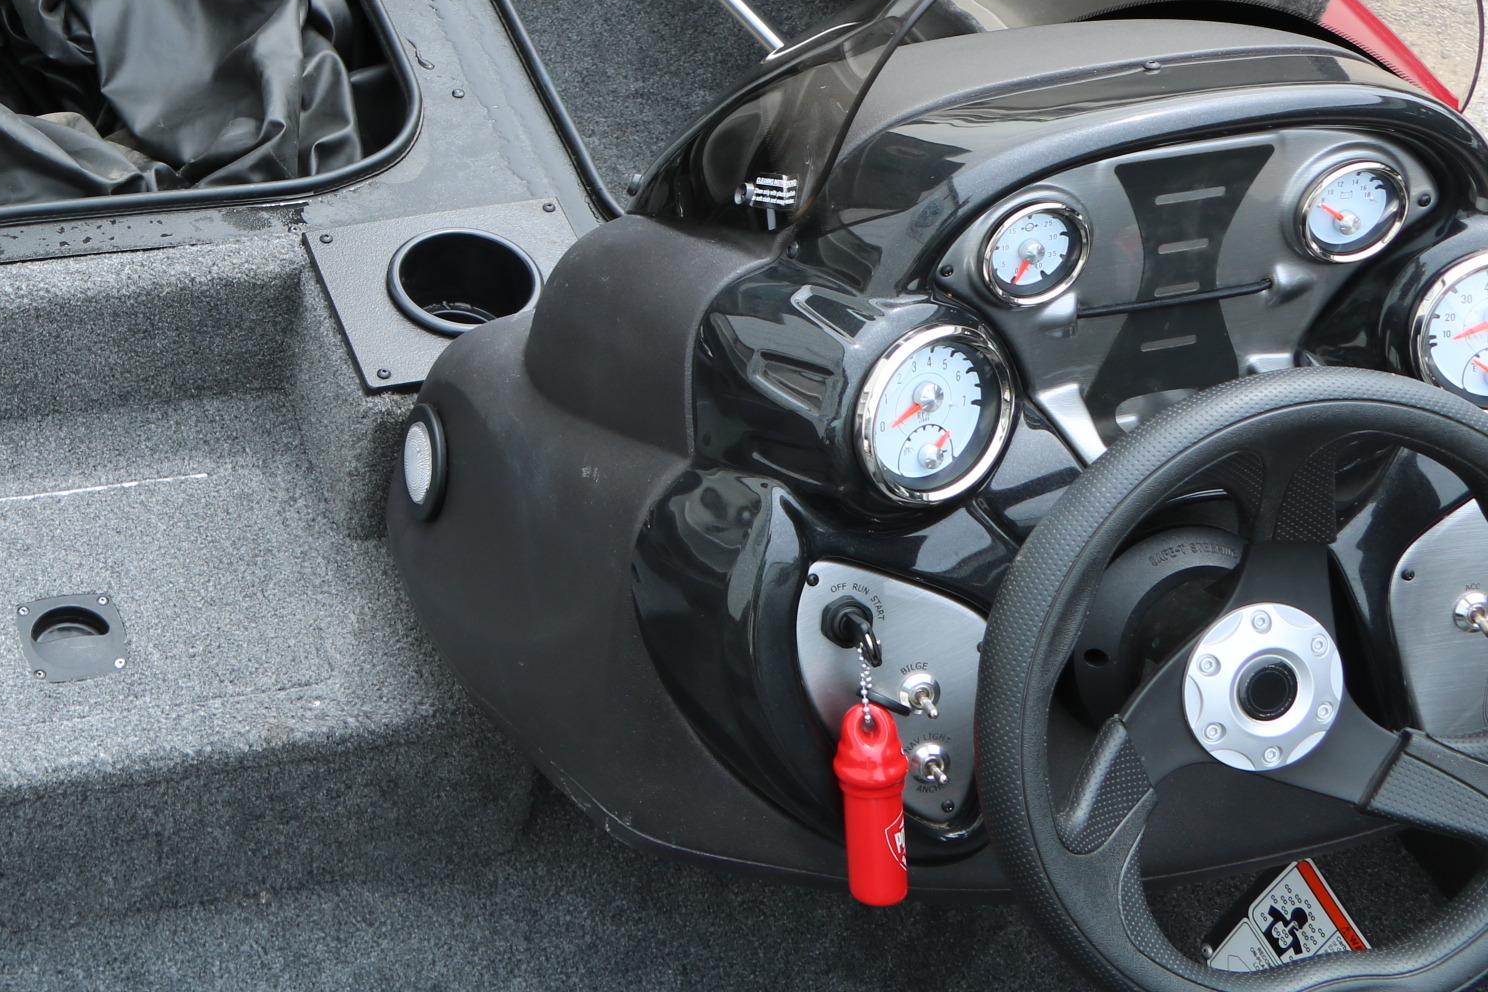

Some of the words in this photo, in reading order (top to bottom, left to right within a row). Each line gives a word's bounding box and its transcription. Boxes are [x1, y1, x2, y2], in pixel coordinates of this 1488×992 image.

[1460, 294, 1473, 304] 30
[1445, 312, 1456, 322] 20
[1443, 329, 1451, 338] 10
[927, 356, 932, 367] 4
[943, 358, 948, 370] 5
[912, 361, 917, 373] 3
[955, 371, 961, 382] 6
[879, 420, 886, 433] 0
[830, 582, 848, 593] OFF
[852, 583, 870, 595] RUN
[870, 595, 885, 621] START
[900, 661, 929, 676] BILGE
[904, 736, 920, 754] NAV
[923, 732, 951, 744] LIGHT
[1285, 884, 1292, 894] CO
[1271, 895, 1278, 904] CO
[1281, 895, 1288, 905] CO
[1288, 896, 1295, 906] CO
[1295, 894, 1302, 903] CO
[1304, 899, 1311, 909] CO
[1281, 906, 1288, 915] CO
[1260, 912, 1267, 922] CO
[1308, 911, 1315, 921] CO
[1274, 927, 1281, 937] CO
[1309, 923, 1316, 933] CO
[1318, 928, 1325, 937] CO
[1282, 929, 1289, 939] CO
[1302, 931, 1309, 941] CO
[1280, 936, 1287, 945] CO
[1310, 936, 1318, 945] CO
[1303, 943, 1310, 952] CO
